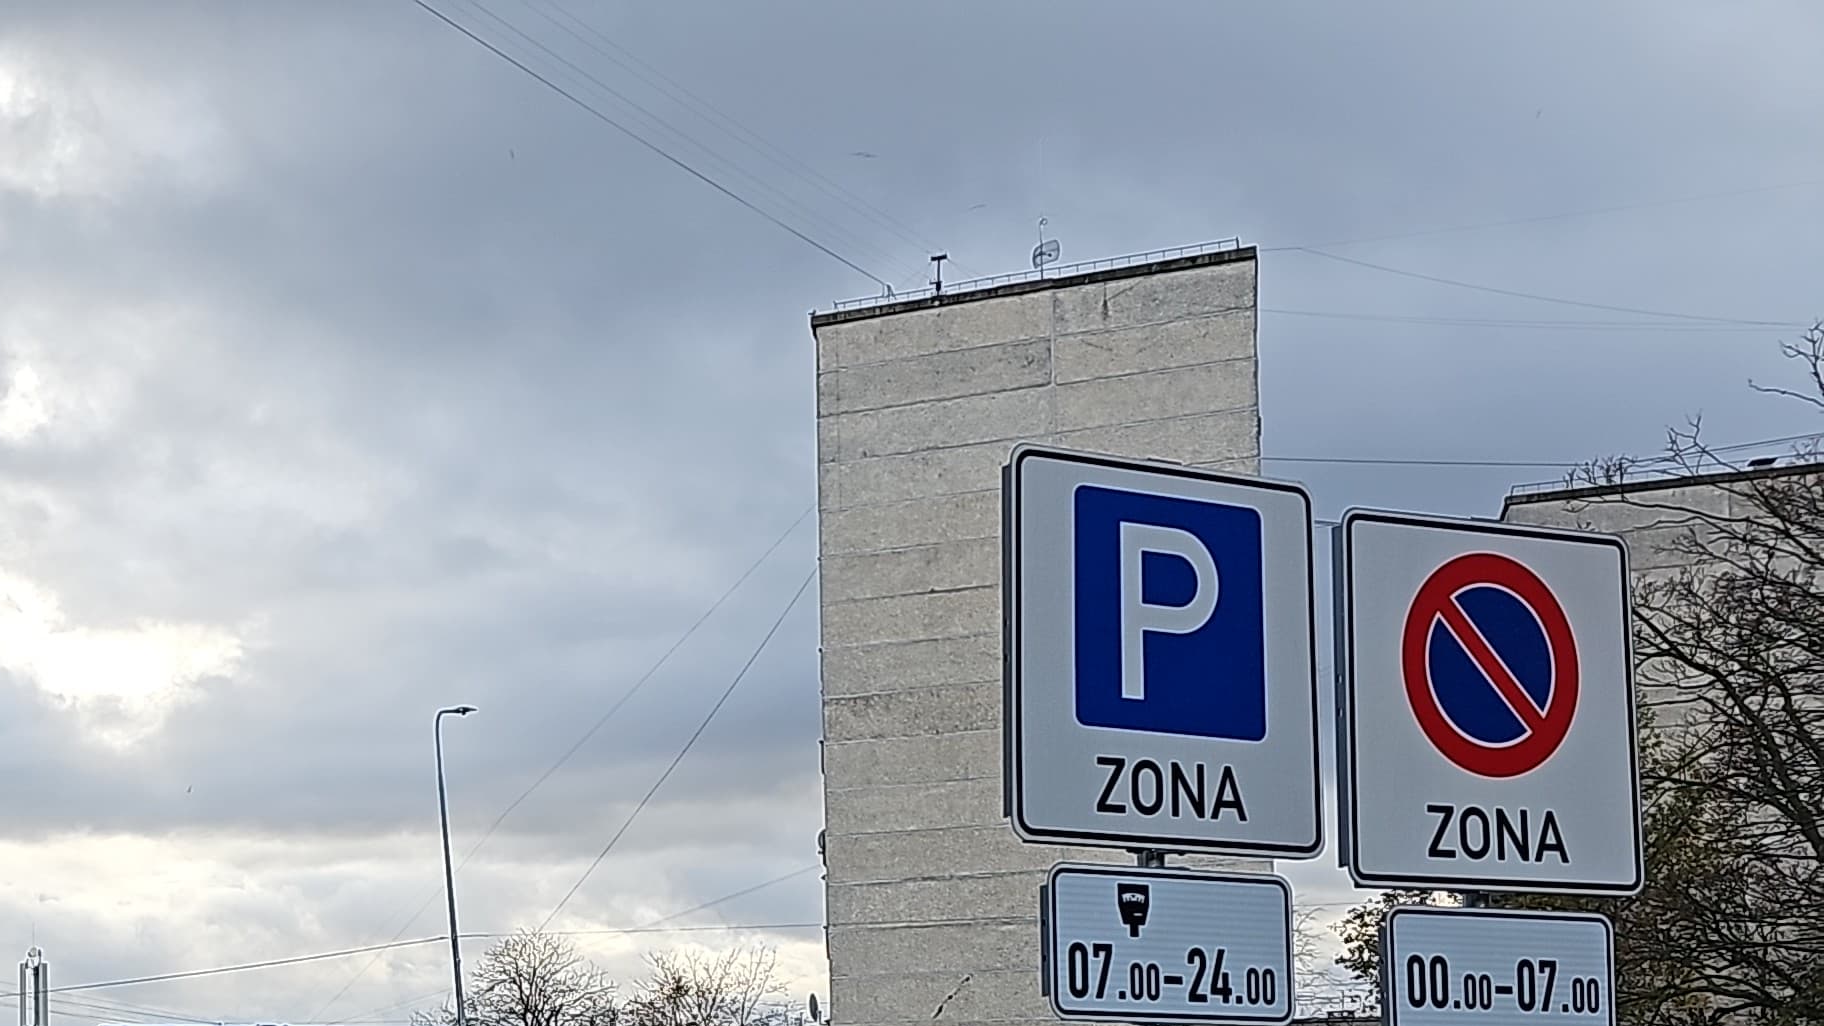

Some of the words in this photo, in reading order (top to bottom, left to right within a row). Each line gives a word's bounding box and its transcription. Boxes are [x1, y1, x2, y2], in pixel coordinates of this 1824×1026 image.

[1119, 520, 1219, 700] P
[1095, 756, 1249, 822] ZONA
[1426, 803, 1571, 864] ZONA
